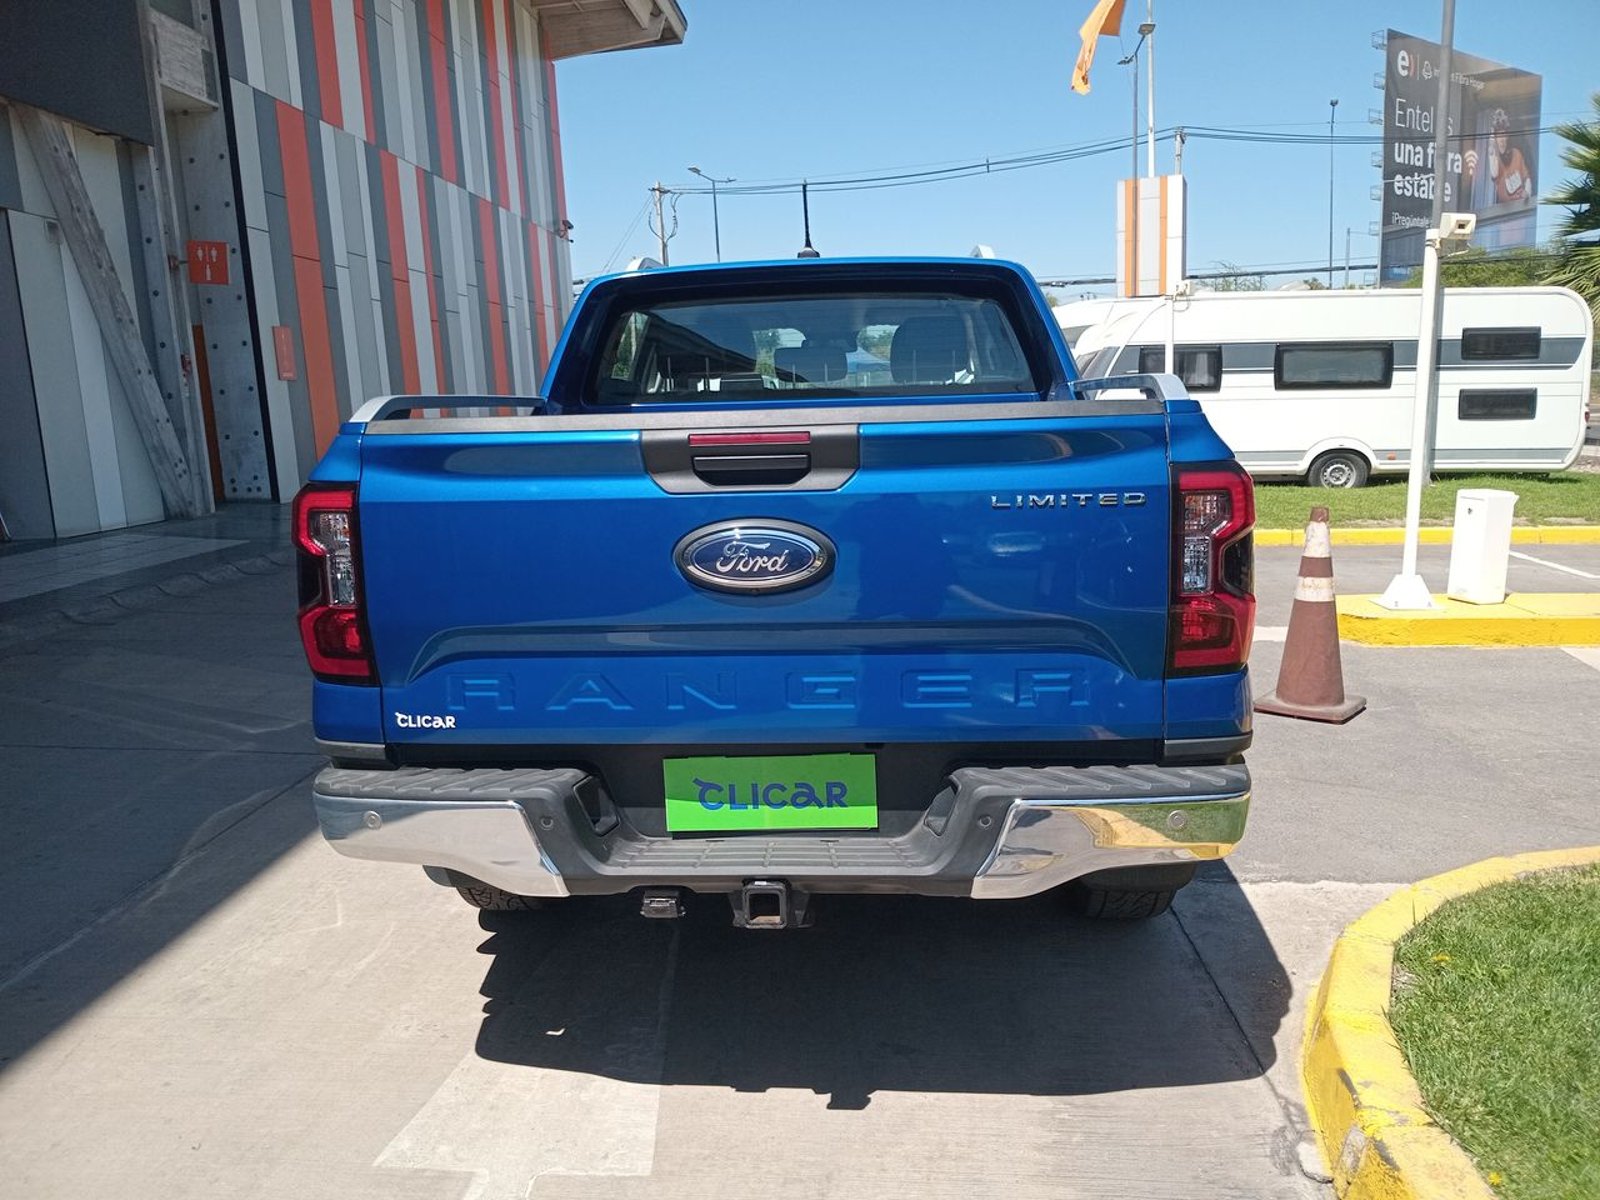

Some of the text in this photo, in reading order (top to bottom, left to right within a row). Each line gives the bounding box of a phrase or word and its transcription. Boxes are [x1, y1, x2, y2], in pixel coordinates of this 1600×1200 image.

[1396, 98, 1434, 133] Entel
[1394, 142, 1462, 173] una fra
[990, 492, 1146, 508] LIMITED
[715, 540, 789, 573] Ford
[447, 667, 1091, 711] RANGER
